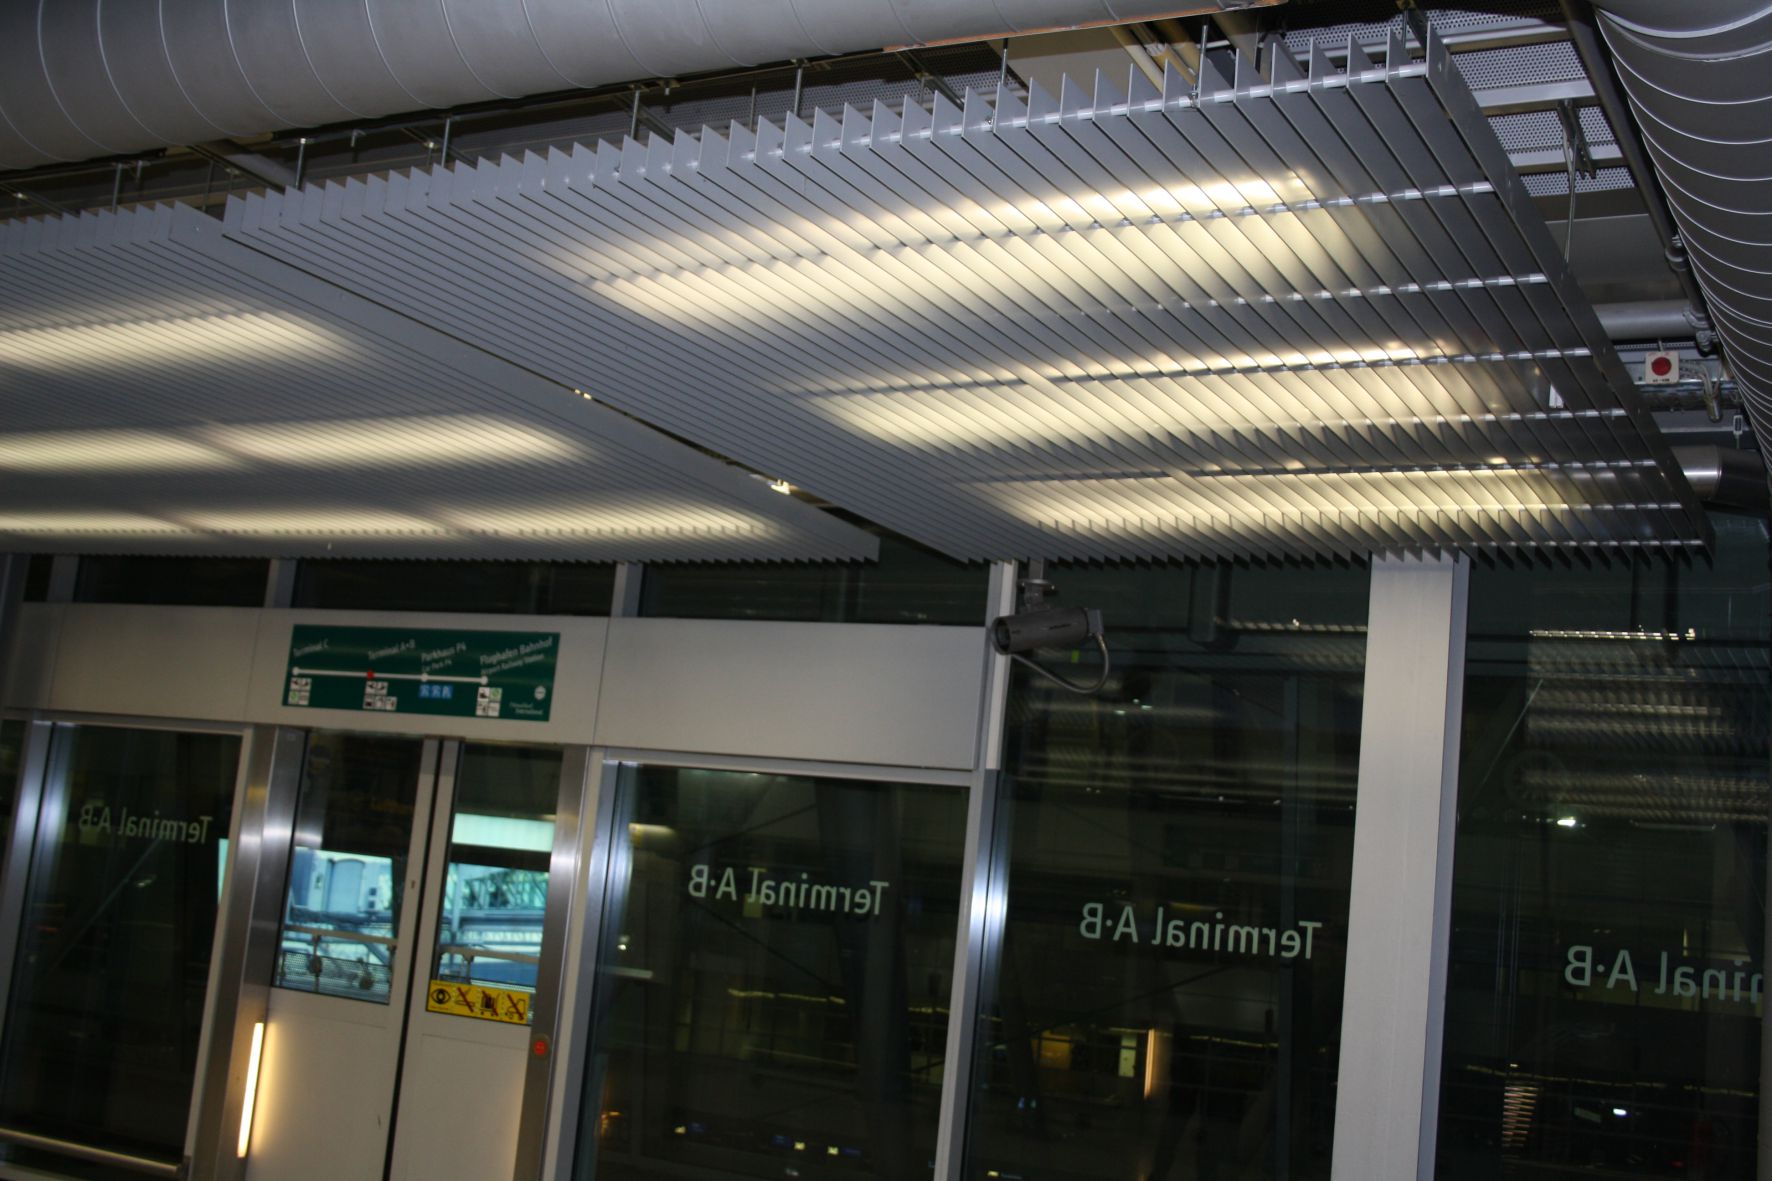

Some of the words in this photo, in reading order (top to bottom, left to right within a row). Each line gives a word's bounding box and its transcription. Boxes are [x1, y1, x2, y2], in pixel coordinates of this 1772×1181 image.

[421, 646, 456, 662] Parkhaus
[455, 641, 467, 654] P4
[480, 648, 519, 665] Flughafen
[519, 635, 553, 655] Bahnhof
